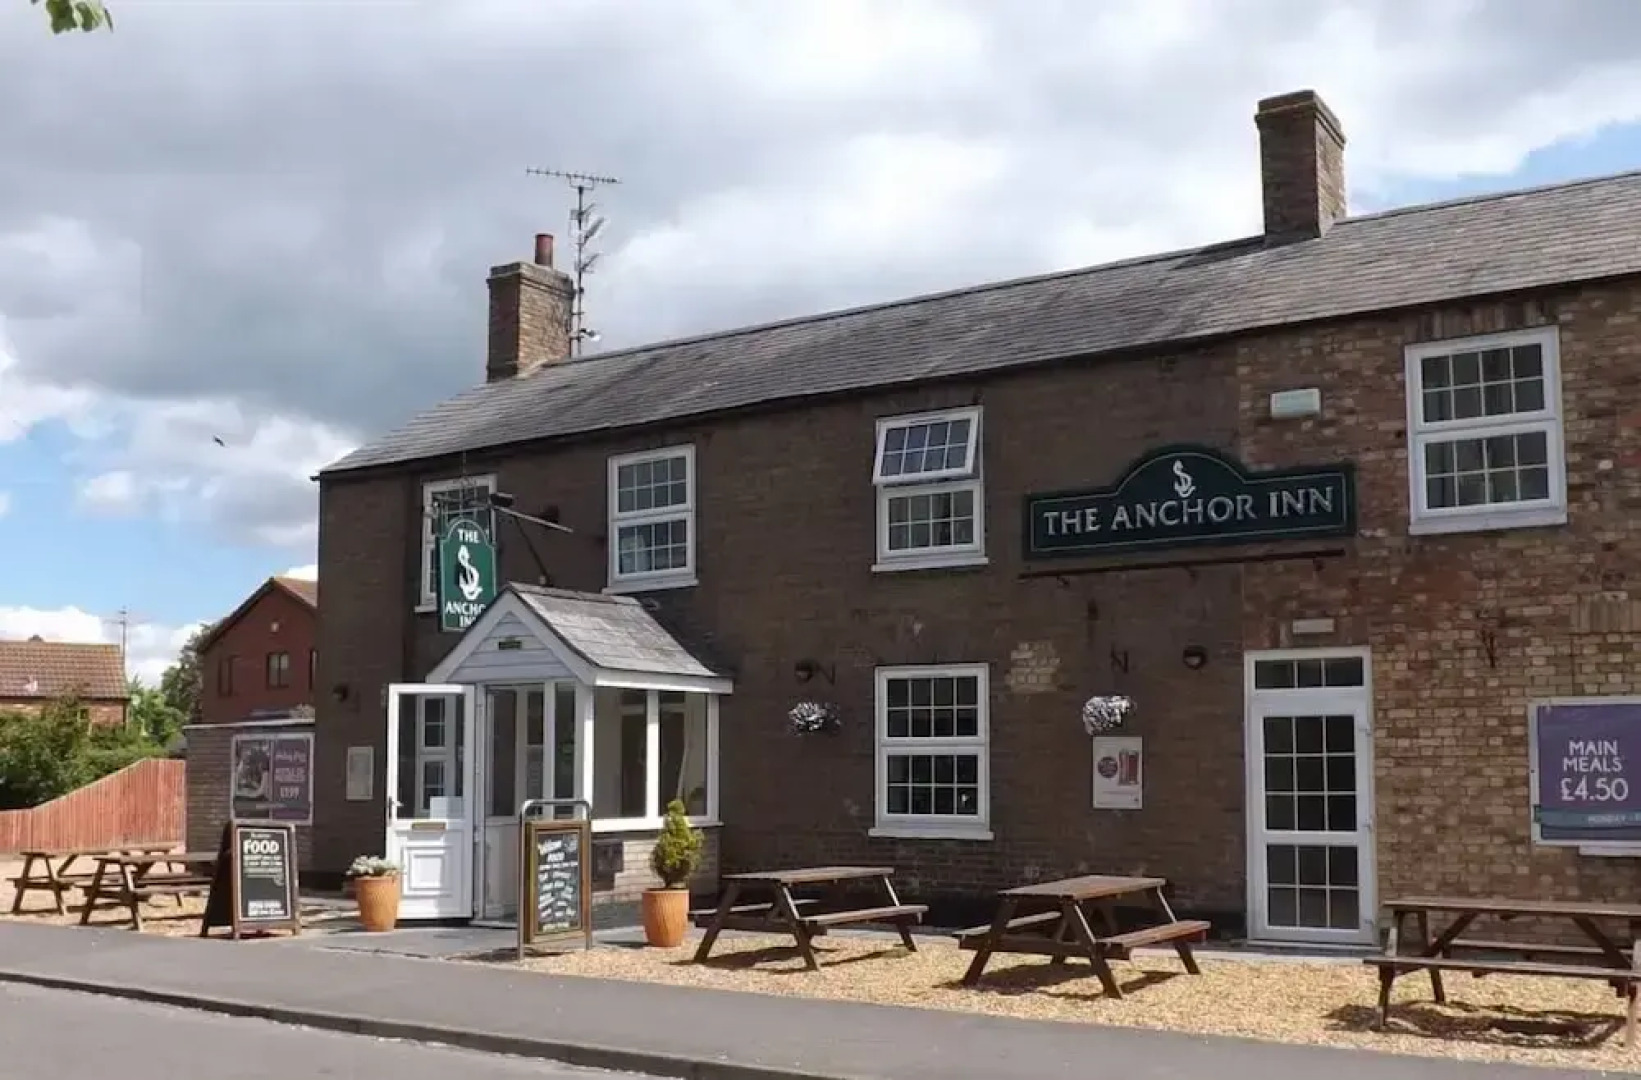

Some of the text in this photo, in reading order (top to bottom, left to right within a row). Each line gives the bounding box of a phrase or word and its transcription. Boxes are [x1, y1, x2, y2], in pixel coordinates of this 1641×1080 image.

[1043, 486, 1334, 536] THE ANCHOR INN
[457, 528, 480, 544] THE
[1568, 739, 1618, 756] MAIN
[1563, 756, 1622, 773] MEALS
[1560, 775, 1629, 802] £4.50
[242, 839, 280, 855] FOOD
